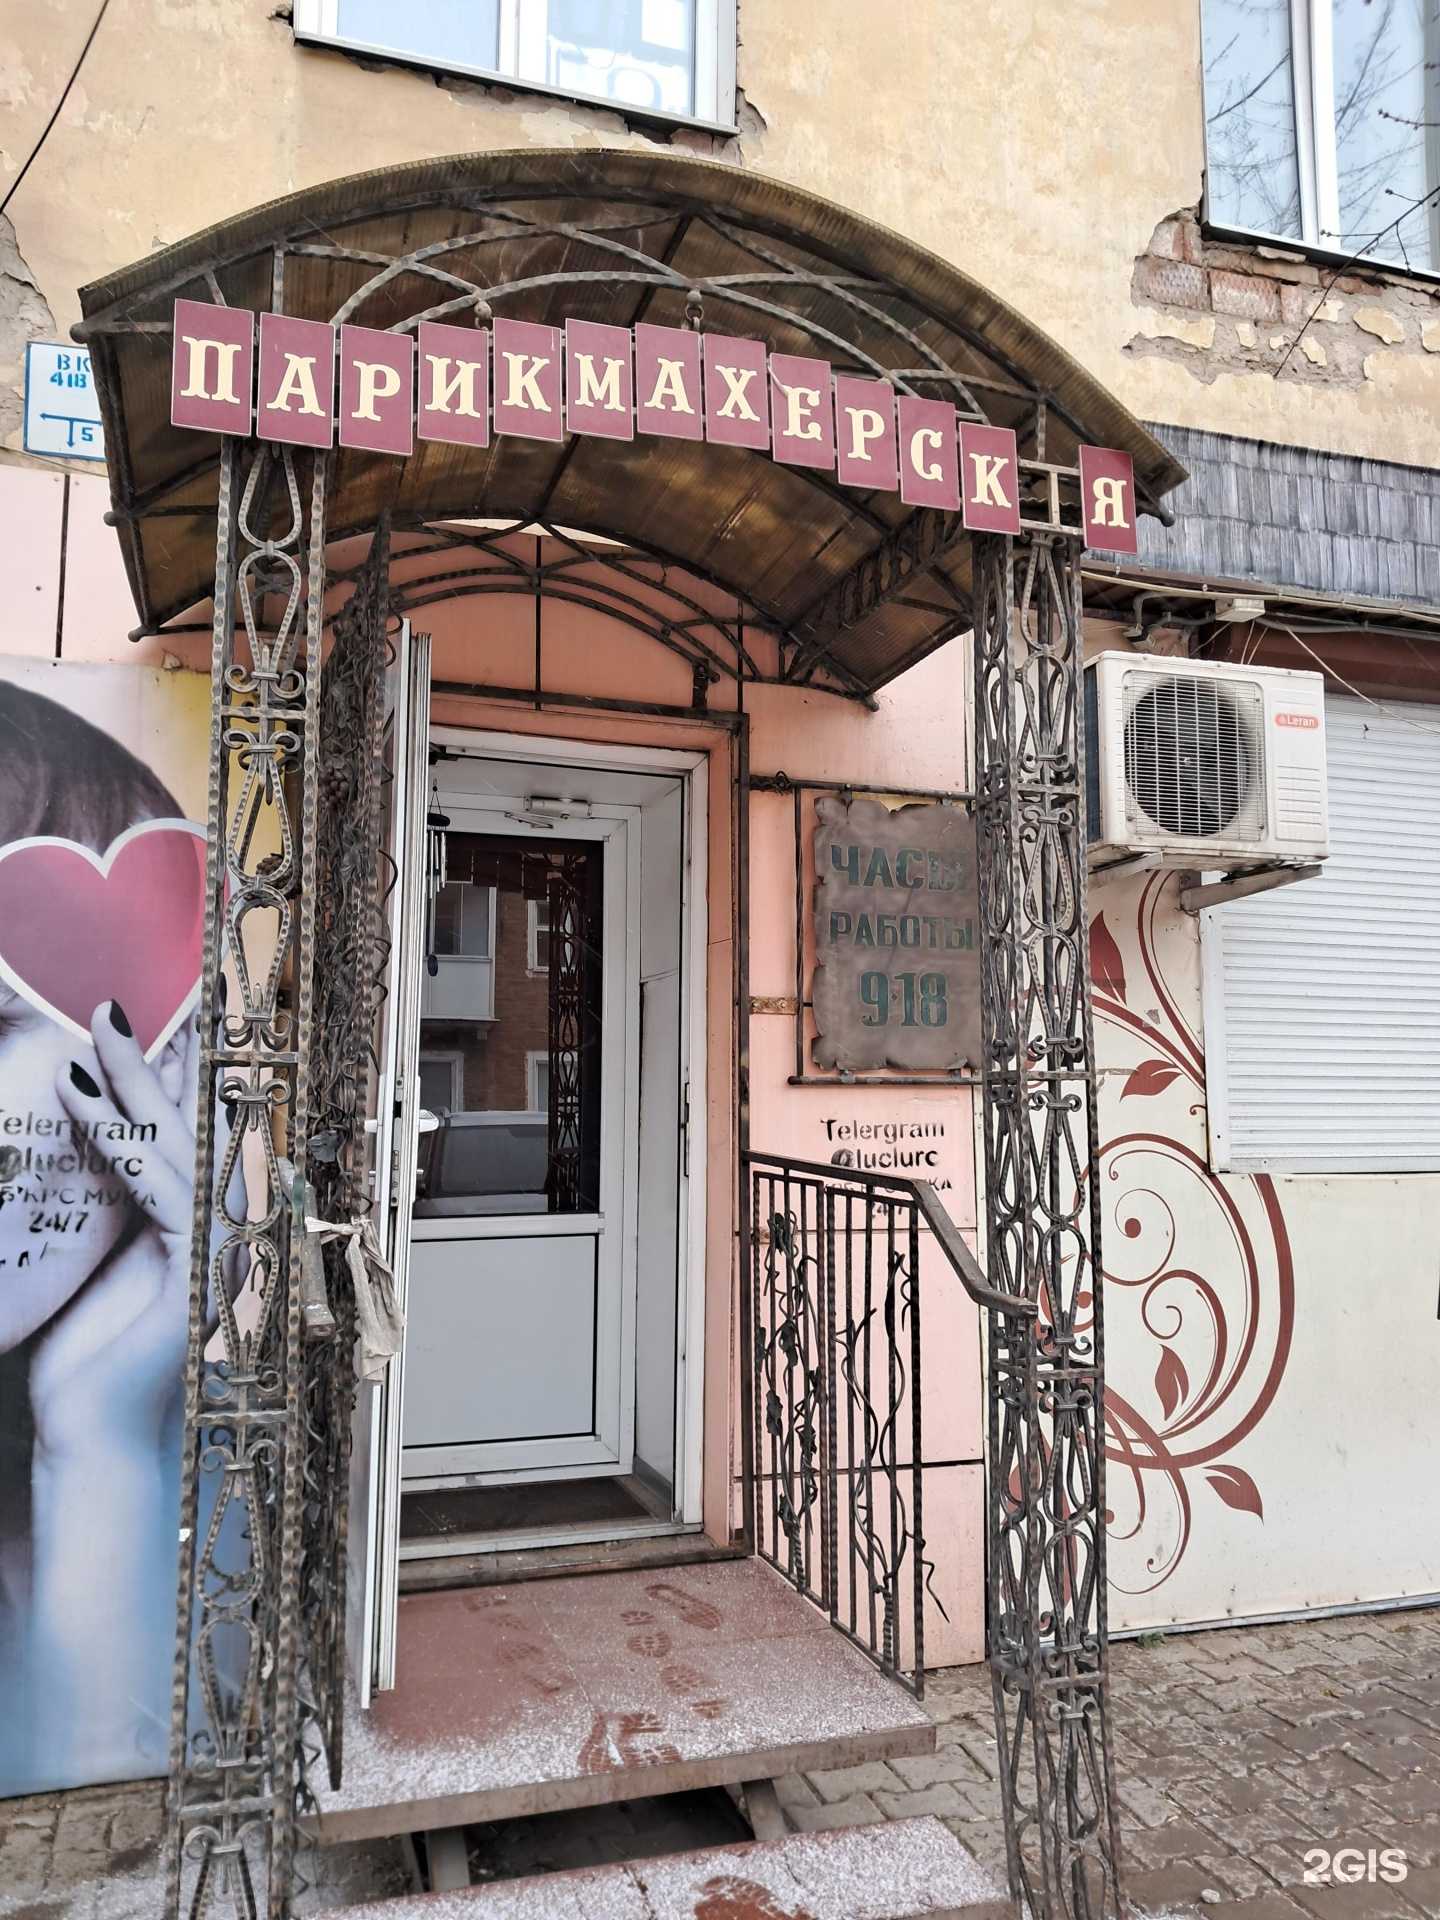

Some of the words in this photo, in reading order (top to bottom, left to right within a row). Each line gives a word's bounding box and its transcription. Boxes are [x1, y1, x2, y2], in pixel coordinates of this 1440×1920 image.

[180, 335, 1130, 529] ПАРИКМАХЕРСКЯ
[831, 845, 967, 890] ЧАСЫ
[829, 911, 975, 950] РАБОТЫ
[820, 1119, 945, 1145] Telergram
